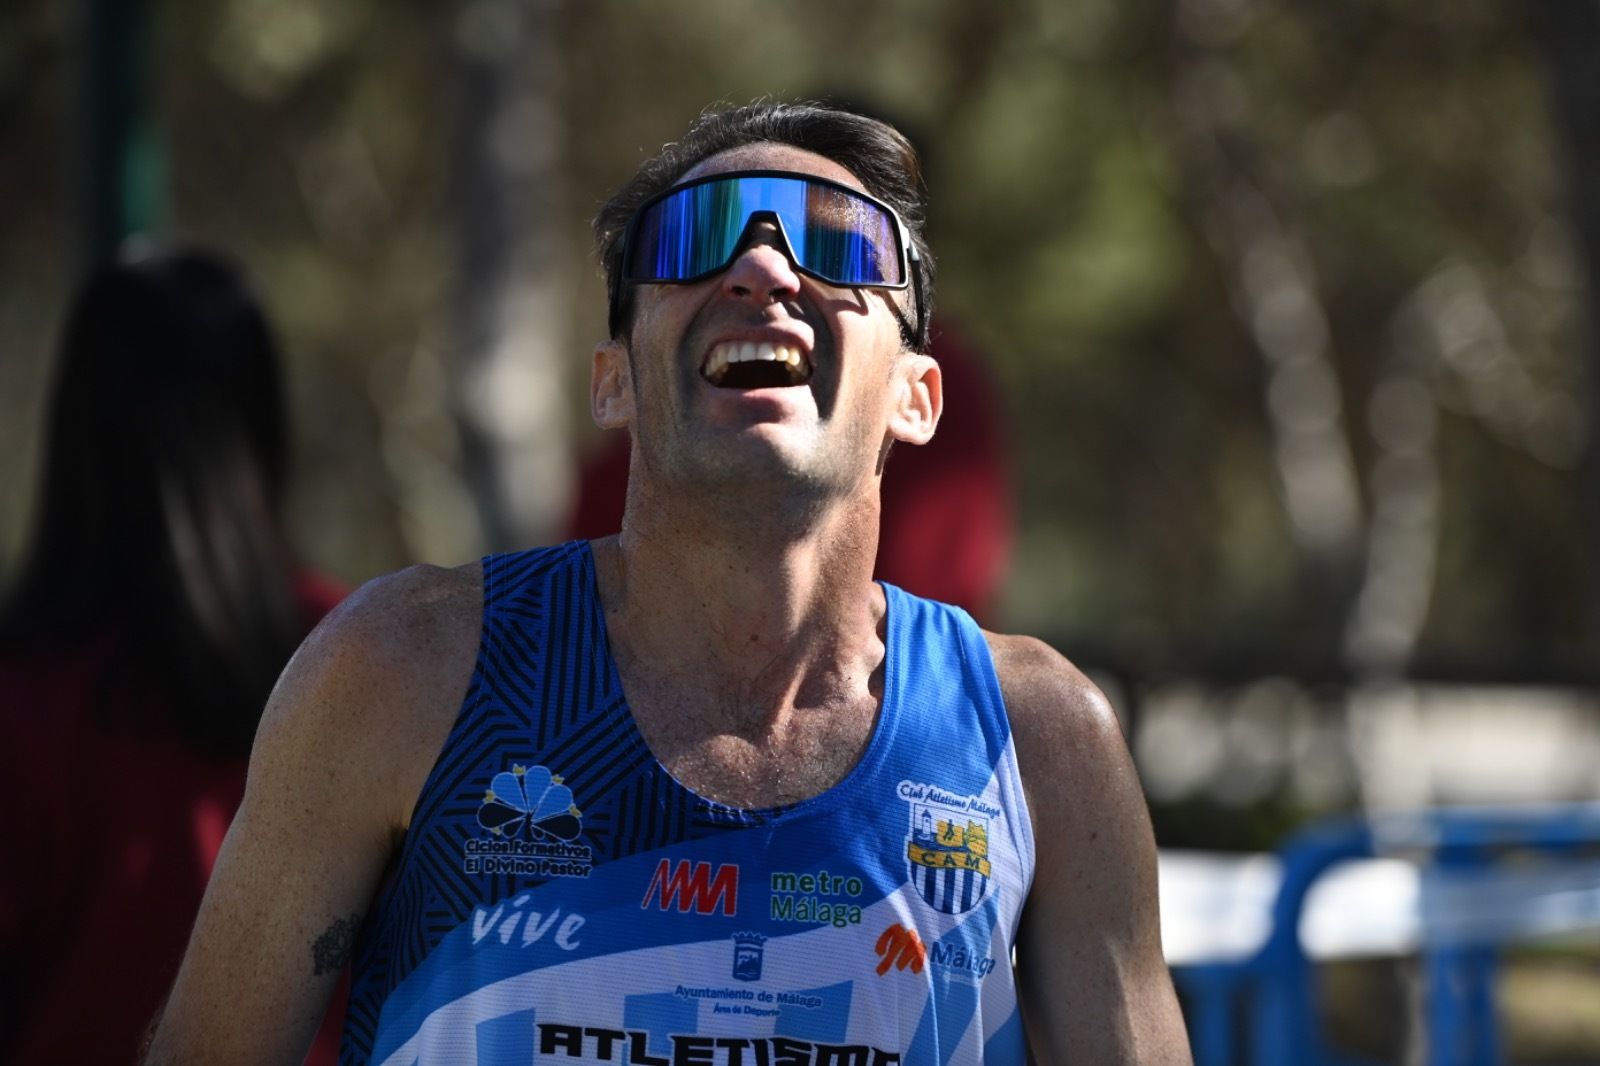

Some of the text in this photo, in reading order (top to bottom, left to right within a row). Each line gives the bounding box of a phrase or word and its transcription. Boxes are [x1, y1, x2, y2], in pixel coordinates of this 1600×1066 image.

[900, 783, 924, 799] Club
[464, 838, 592, 859] Ciclos Formativos
[464, 857, 592, 879] El Divino Pastor
[771, 871, 862, 896] metro
[771, 895, 862, 928] Málaga
[930, 941, 996, 979] Málaga
[674, 983, 823, 1009] Ayuntamiento de Málaga
